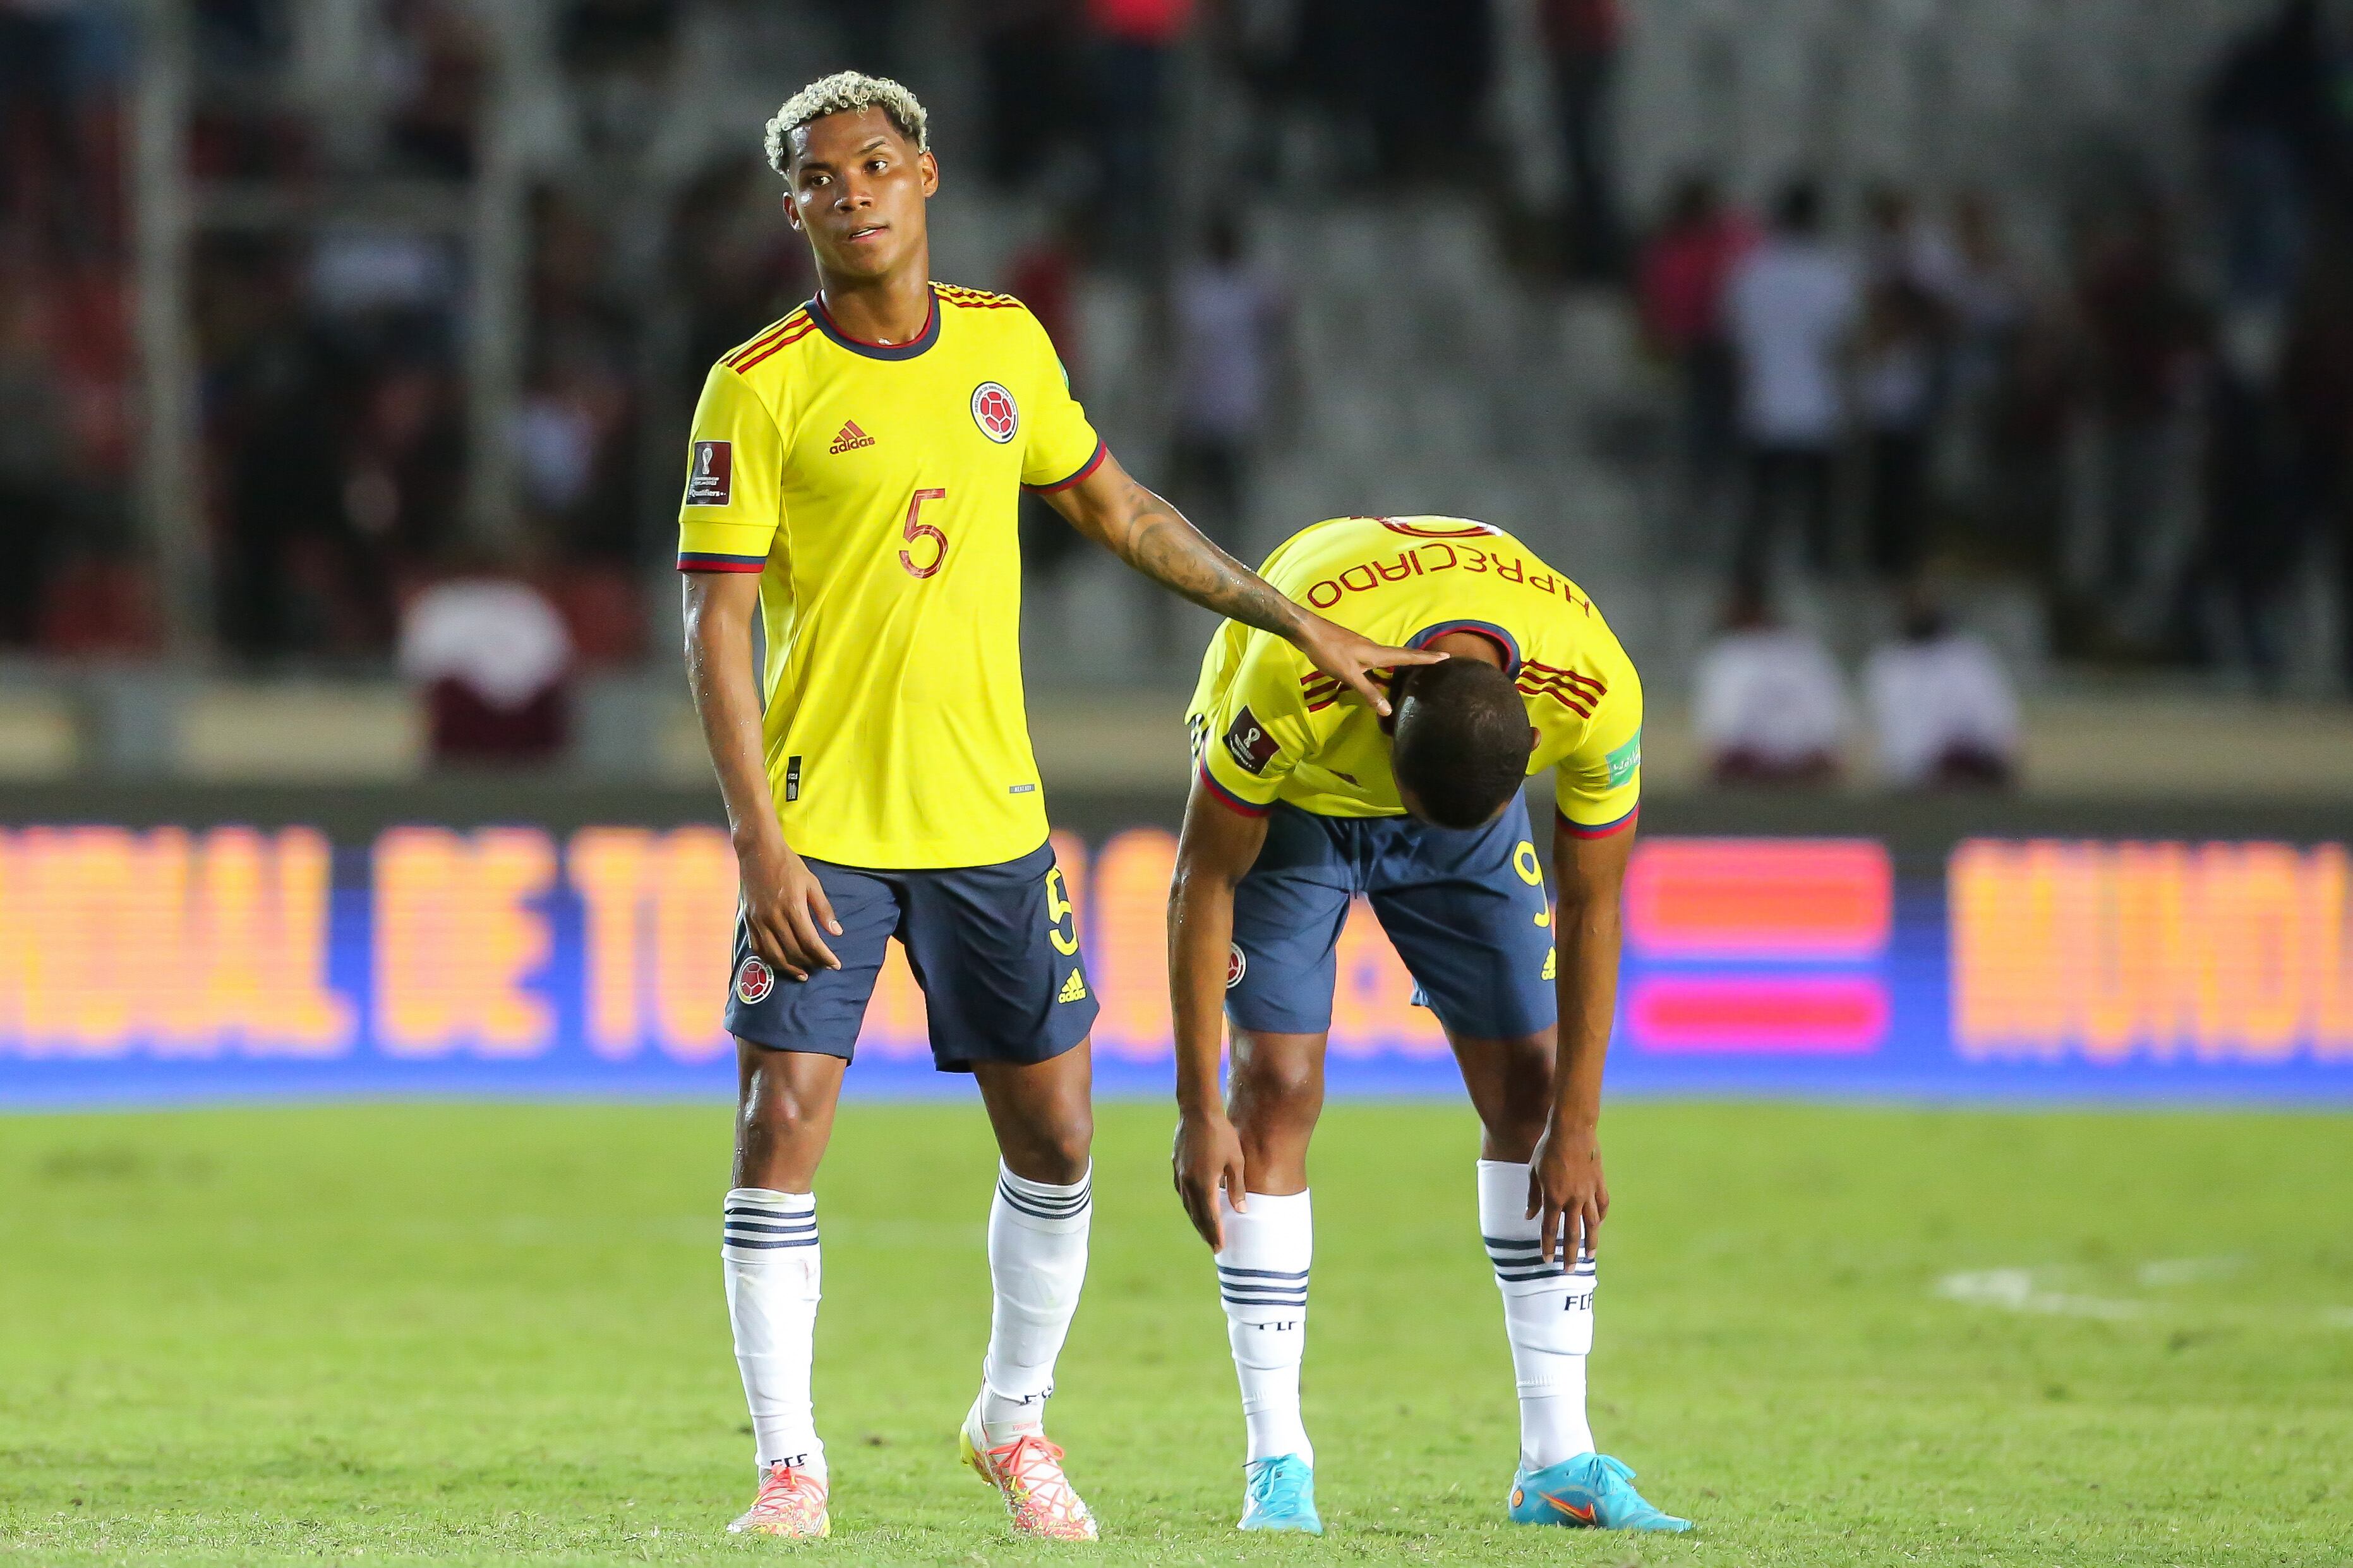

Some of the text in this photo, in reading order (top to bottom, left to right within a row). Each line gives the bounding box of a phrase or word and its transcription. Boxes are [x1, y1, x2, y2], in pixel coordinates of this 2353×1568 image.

[829, 437, 875, 454] adidas
[899, 488, 948, 578] 5
[1307, 543, 1590, 618] H.PRECIADO
[1044, 865, 1079, 956] 5
[1513, 840, 1550, 928] 9
[1057, 988, 1087, 1004] adidas
